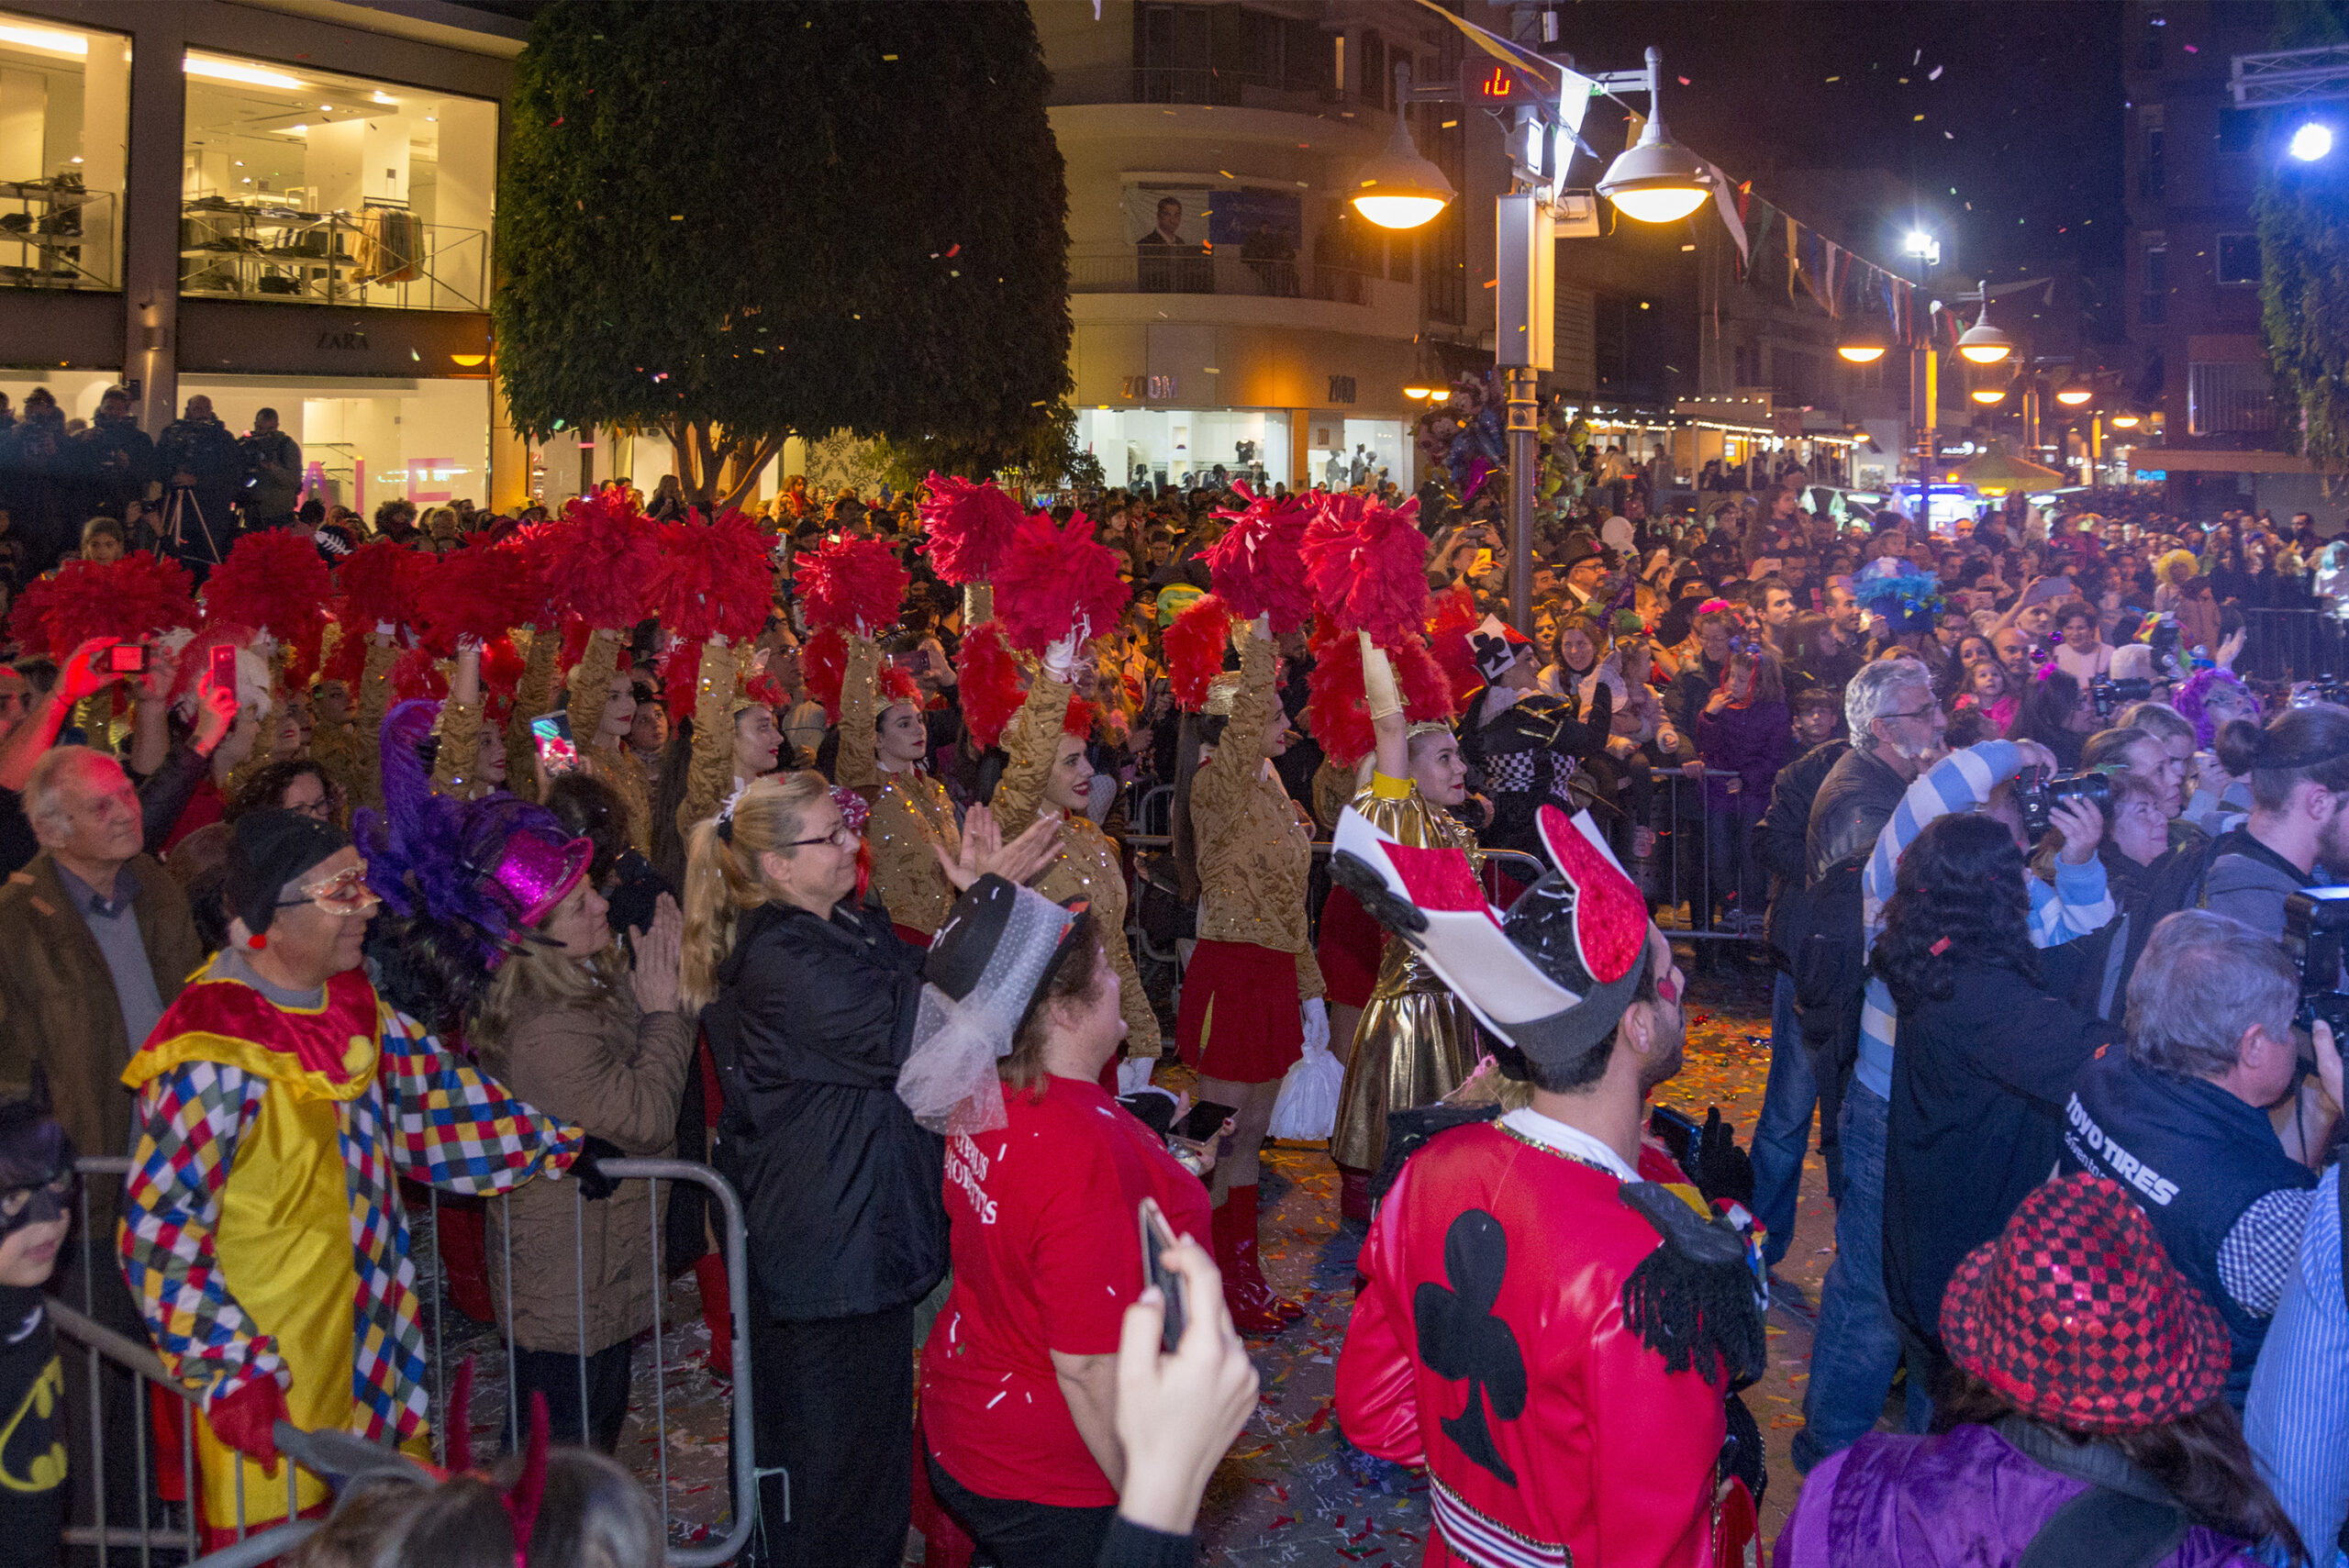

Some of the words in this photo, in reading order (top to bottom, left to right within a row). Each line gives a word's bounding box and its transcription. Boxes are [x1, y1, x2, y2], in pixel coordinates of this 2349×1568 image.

[316, 331, 370, 350] ZARA
[1120, 375, 1178, 399] ZOOM
[2065, 1092, 2104, 1151] TOYO
[2101, 1135, 2180, 1207] TIRES
